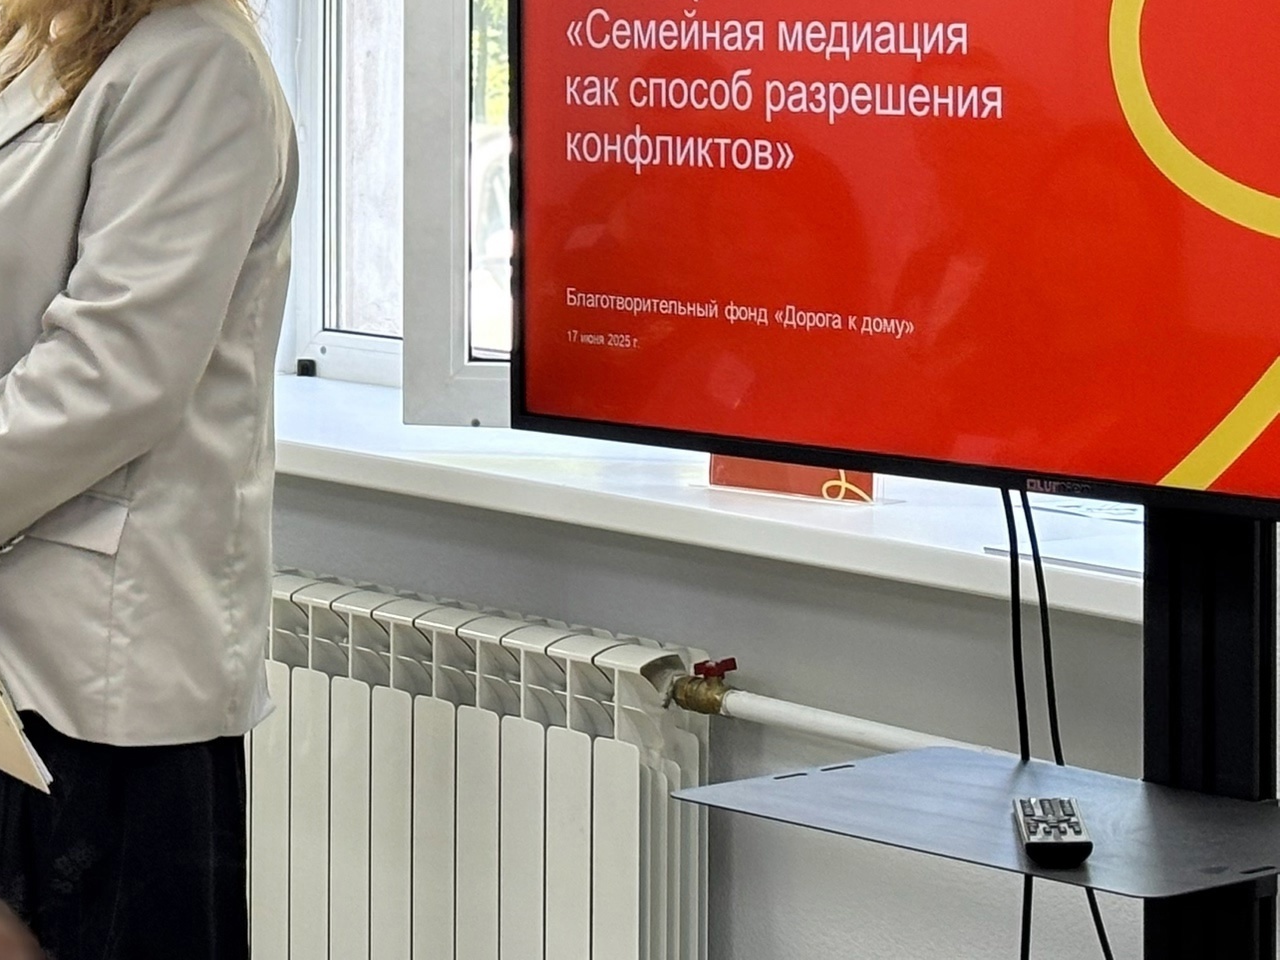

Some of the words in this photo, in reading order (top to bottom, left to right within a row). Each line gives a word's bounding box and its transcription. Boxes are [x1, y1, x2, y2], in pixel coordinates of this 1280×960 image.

[567, 9, 763, 50] «Семейная
[779, 21, 967, 62] медиация
[567, 76, 619, 105] как
[630, 69, 752, 110] способ
[766, 81, 1001, 124] разрешения
[567, 124, 794, 174] конфликтов»
[567, 288, 718, 318] Благотворительный
[725, 301, 768, 325] фонд
[775, 305, 841, 330] «Дорога
[849, 316, 857, 330] к
[861, 317, 914, 338] дому»
[568, 330, 578, 341] 17
[608, 334, 630, 347] 2025
